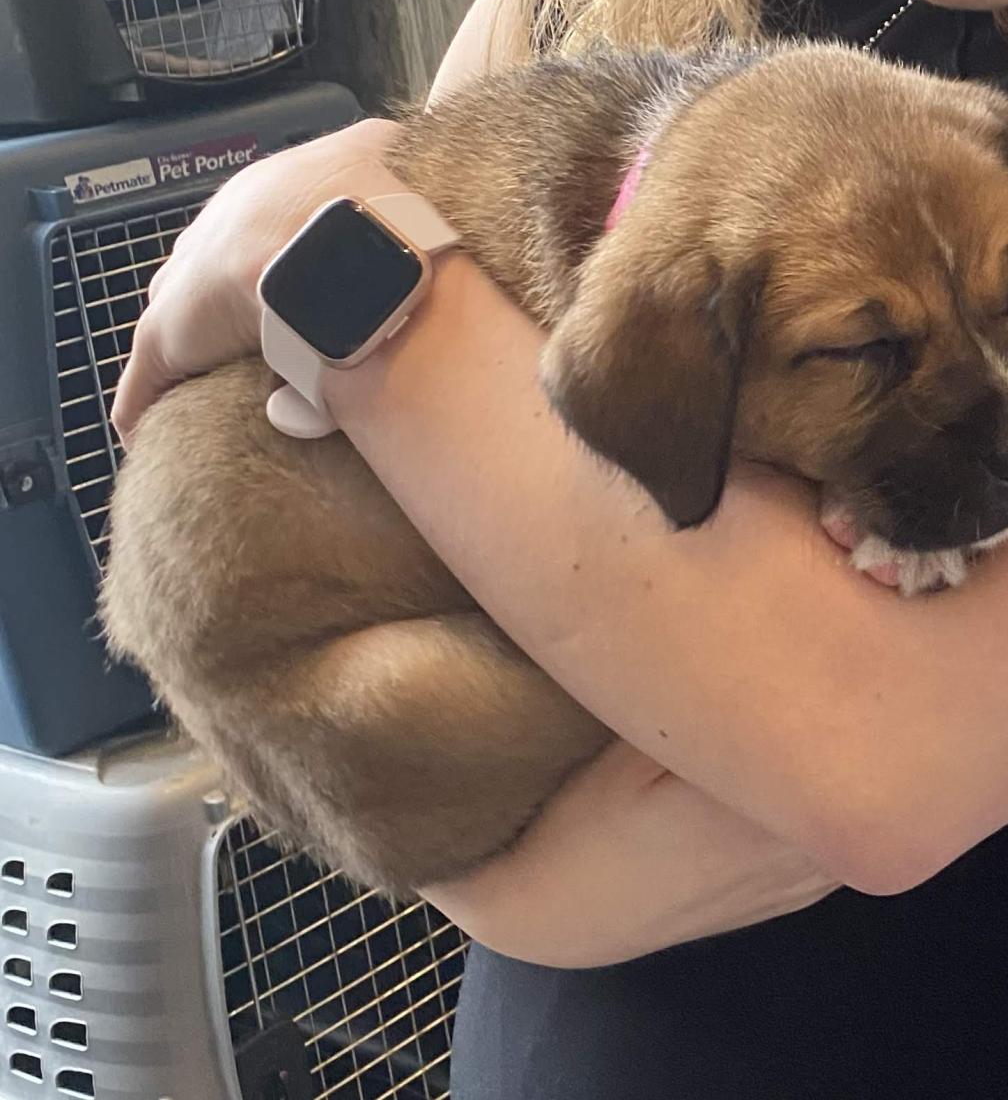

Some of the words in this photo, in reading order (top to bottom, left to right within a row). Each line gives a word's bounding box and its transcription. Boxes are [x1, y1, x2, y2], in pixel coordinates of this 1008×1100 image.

[160, 160, 190, 182] Pet
[195, 148, 253, 173] Porter
[94, 173, 151, 196] Petmate
